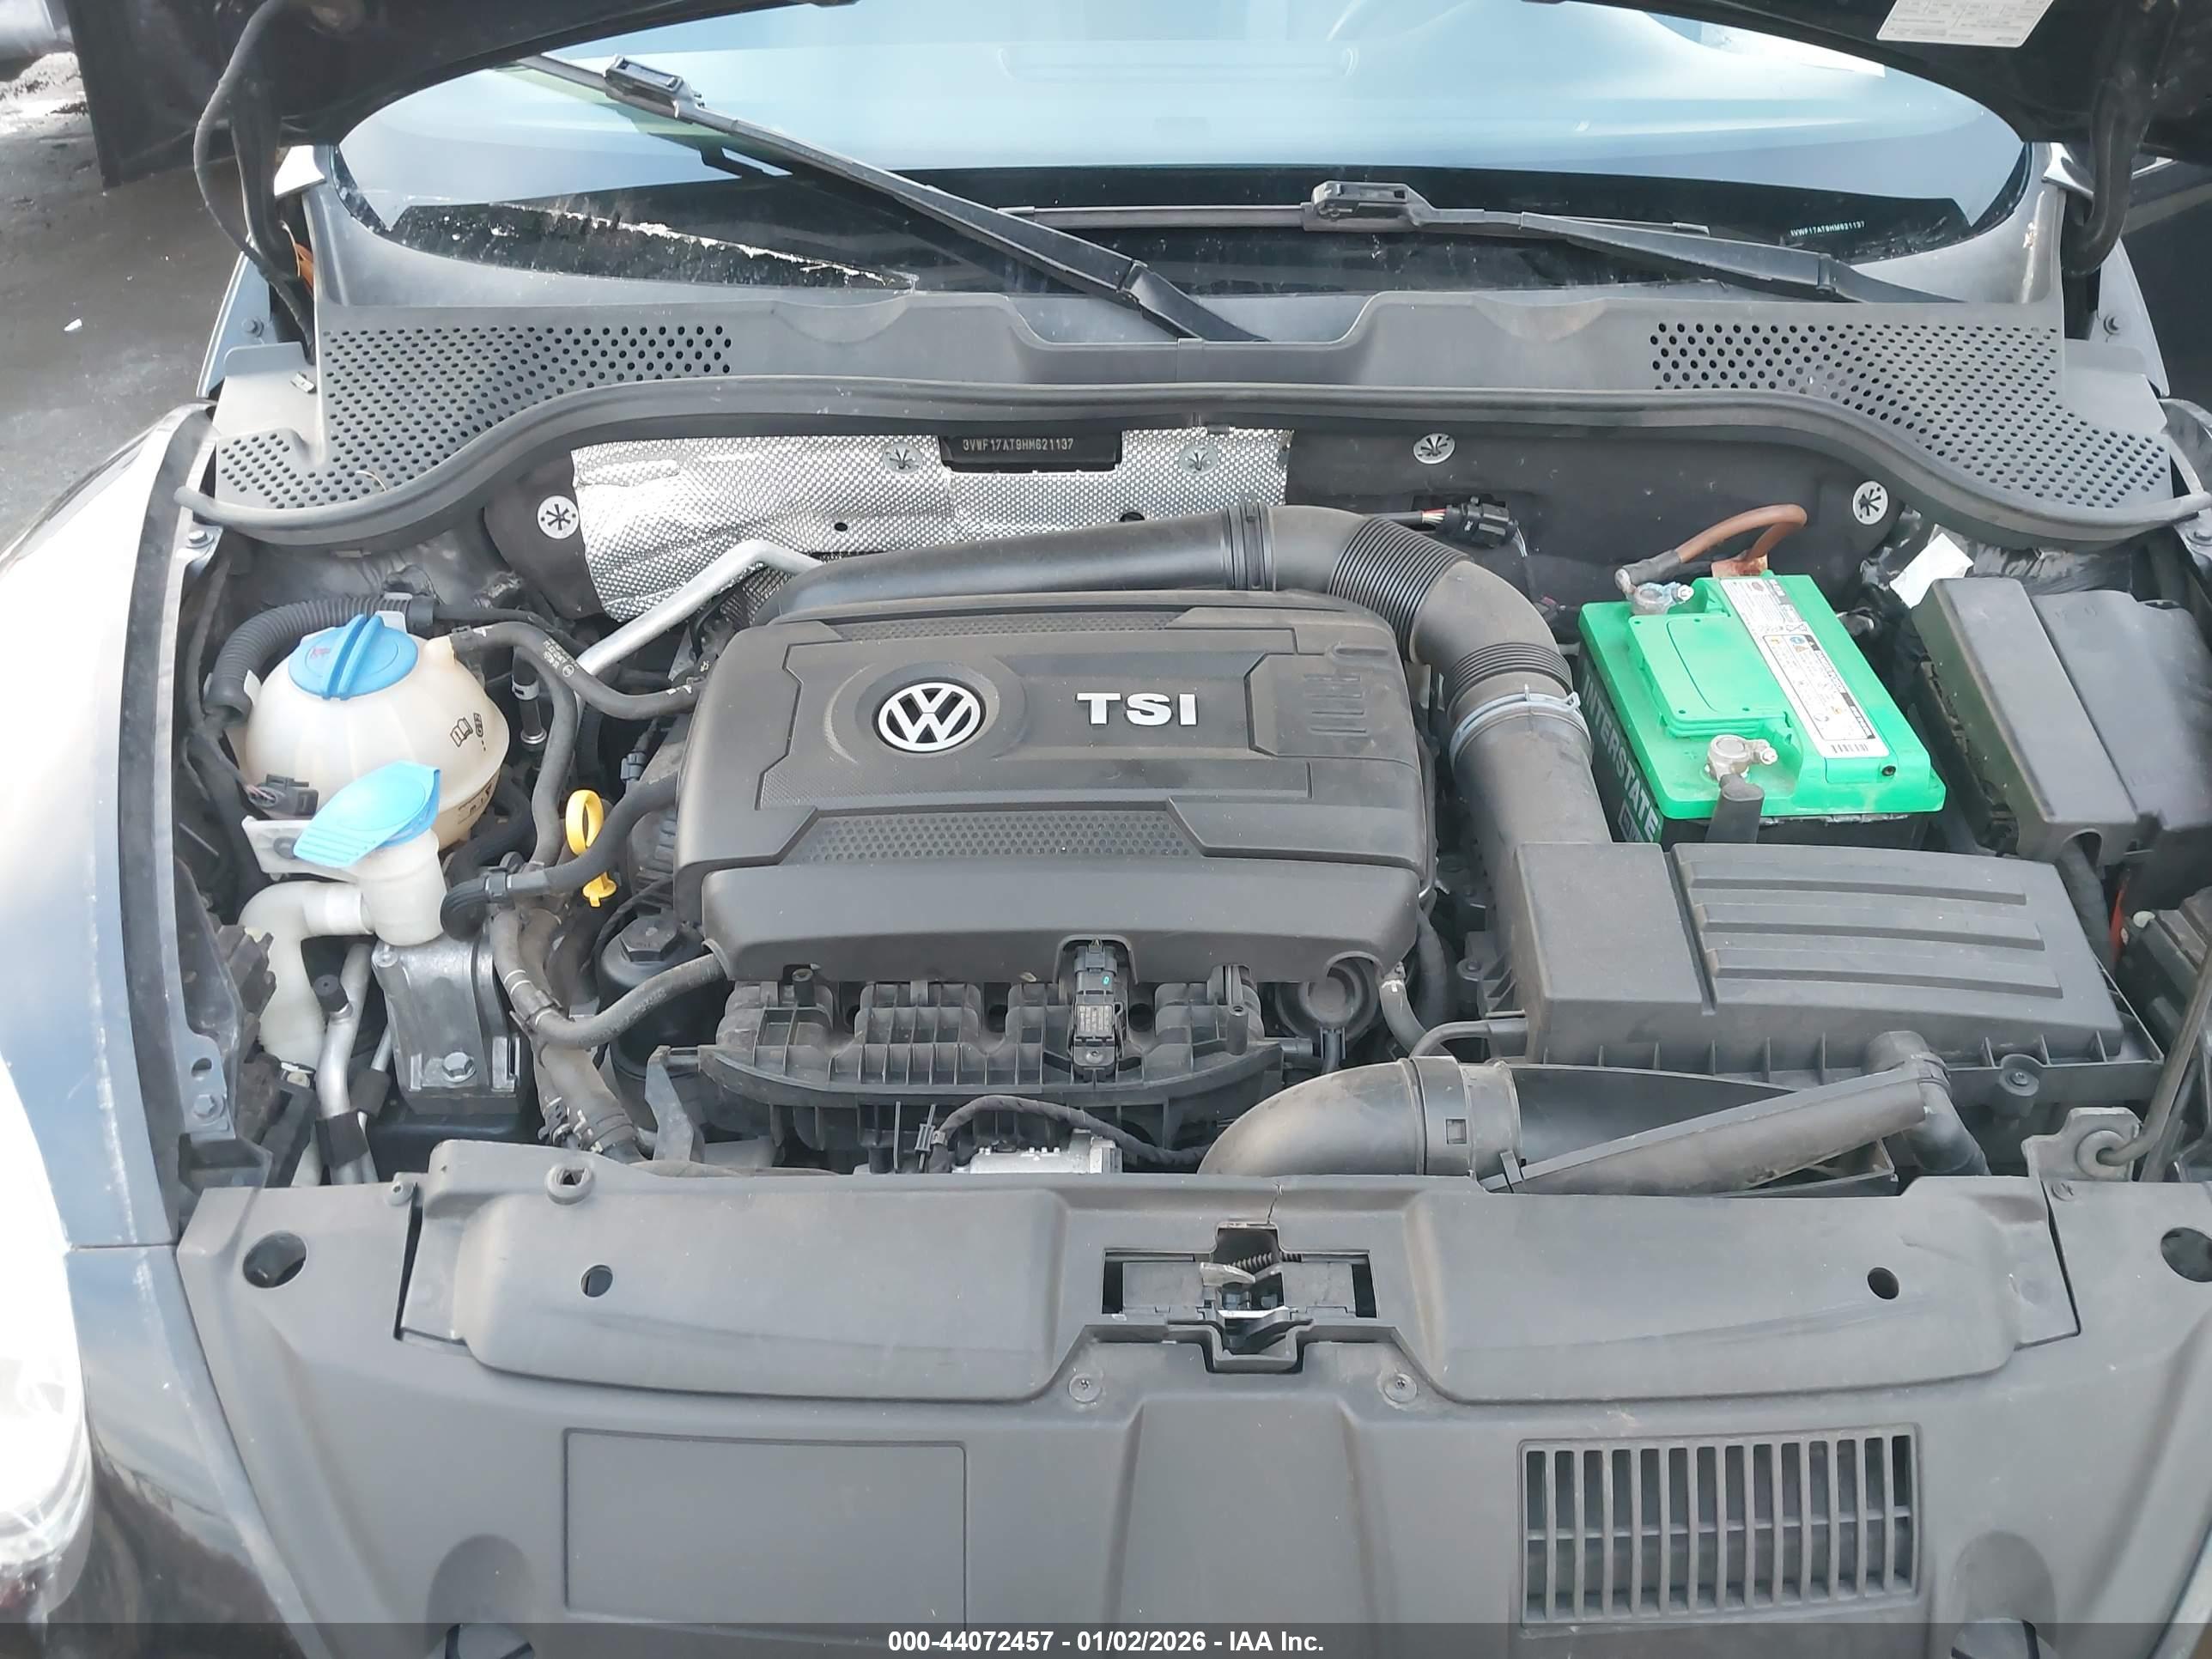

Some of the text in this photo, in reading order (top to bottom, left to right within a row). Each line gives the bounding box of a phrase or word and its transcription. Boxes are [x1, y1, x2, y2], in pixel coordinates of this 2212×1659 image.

[963, 437, 1074, 452] 3VWF17AT9HM621137
[1076, 692, 1199, 726] TSI
[1582, 672, 1659, 842] INTERSTATE
